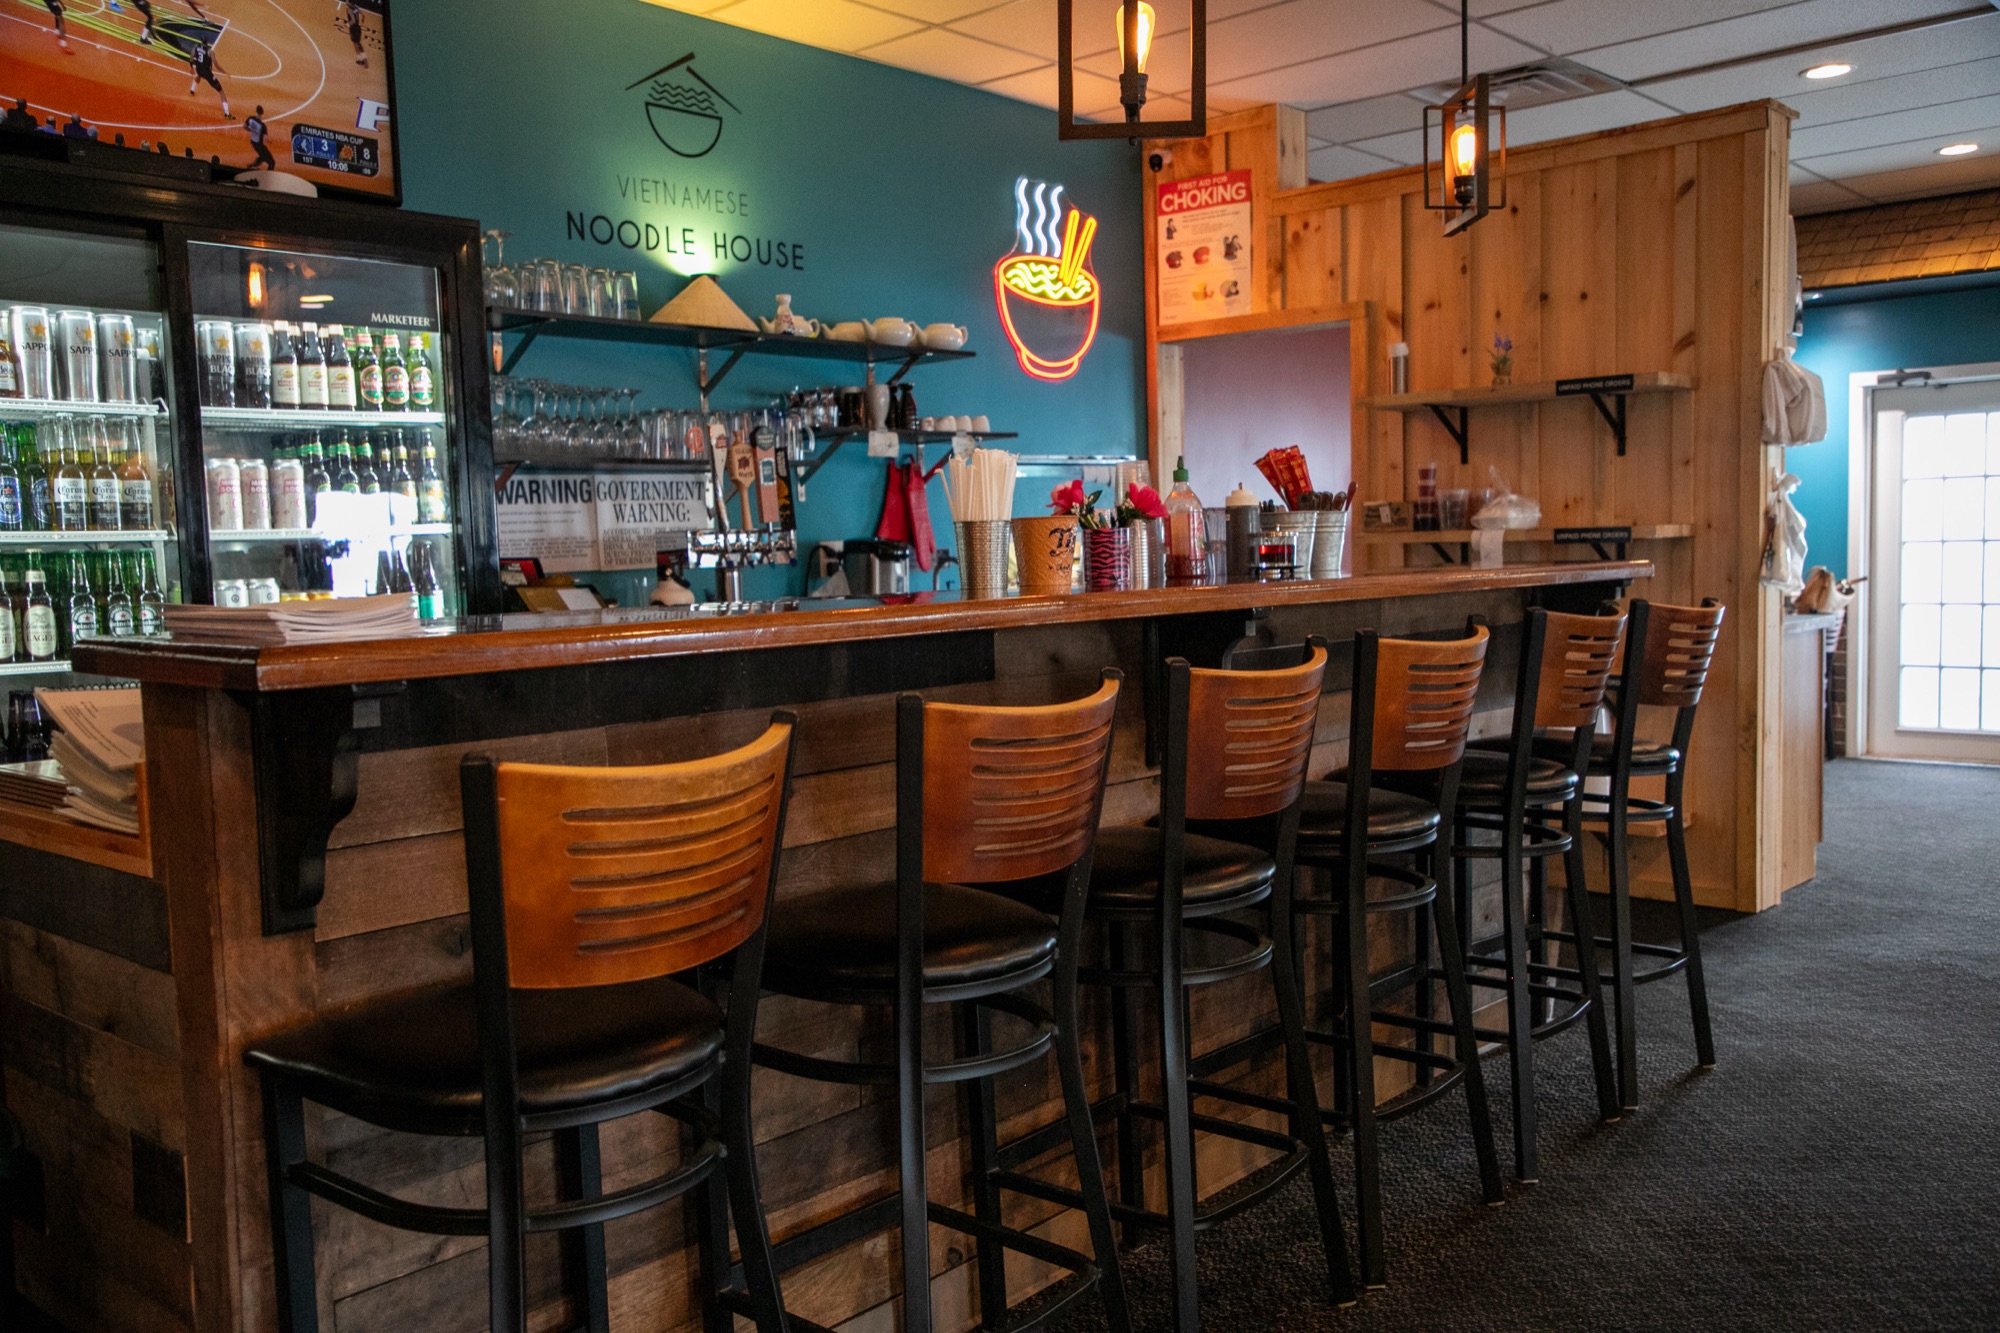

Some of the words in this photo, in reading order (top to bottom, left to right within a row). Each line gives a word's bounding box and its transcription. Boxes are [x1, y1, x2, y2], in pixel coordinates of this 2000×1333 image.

[300, 126, 335, 140] EMIRATES
[335, 133, 349, 143] NBA
[349, 136, 364, 145] CUP
[321, 139, 329, 152] 3
[363, 147, 371, 160] 8
[1178, 181, 1198, 190] FIRST
[1198, 179, 1211, 188] AID
[1213, 176, 1228, 184] FOR
[616, 174, 750, 217] VIETNAMESE
[1161, 182, 1247, 213] CHOKING
[566, 210, 696, 256] NOODLE
[713, 231, 805, 271] HOUSE
[371, 312, 431, 327] MARKETEER
[498, 479, 592, 505] WARNING
[597, 480, 705, 501] GOVERNMENT
[613, 502, 690, 523] WARNING:
